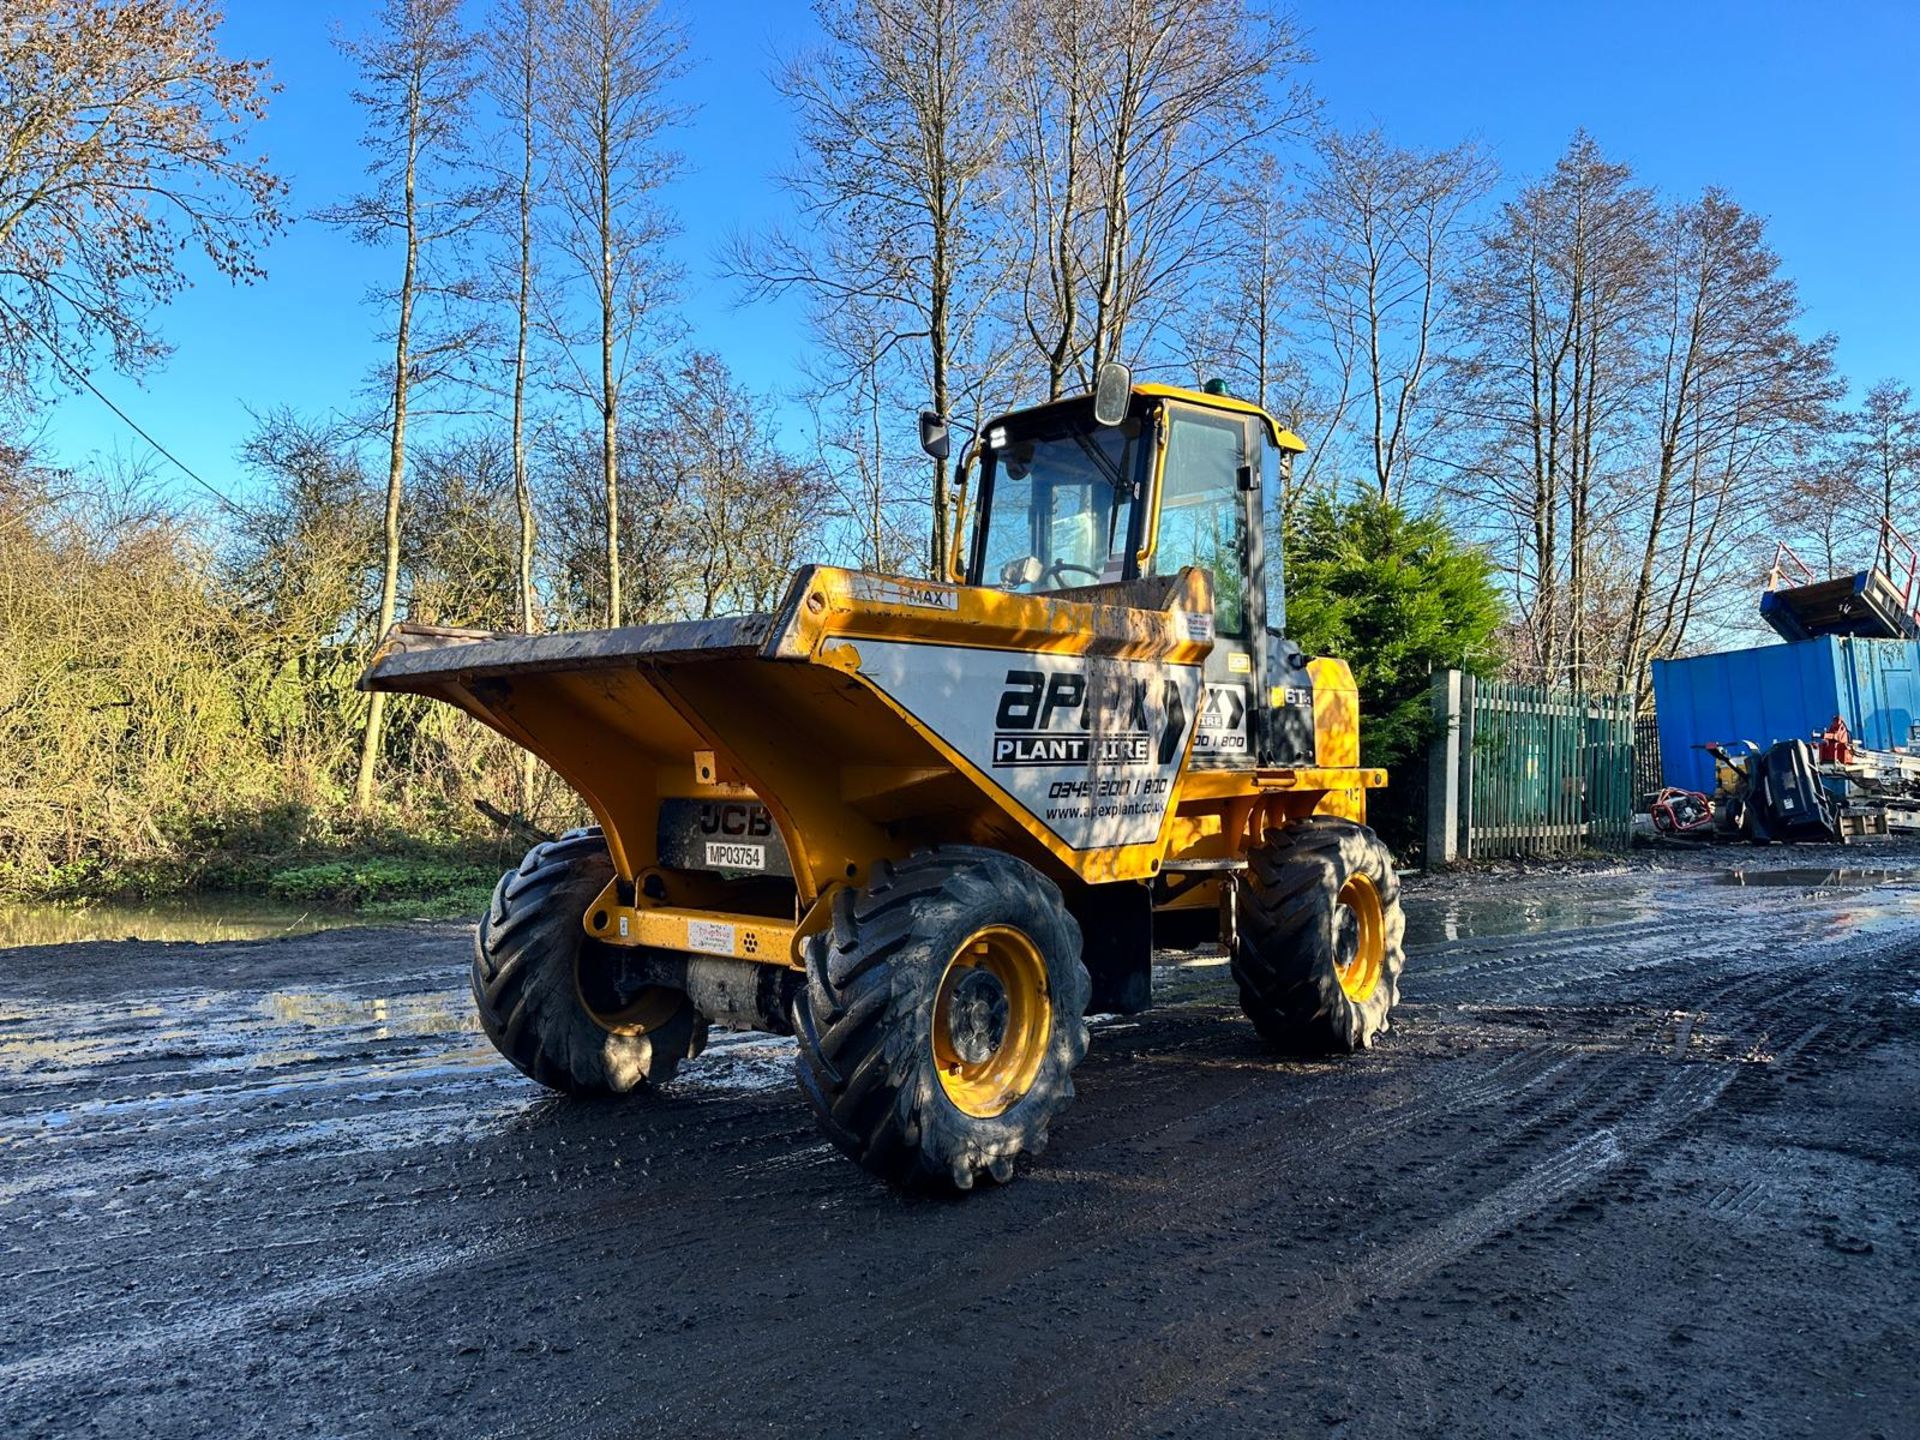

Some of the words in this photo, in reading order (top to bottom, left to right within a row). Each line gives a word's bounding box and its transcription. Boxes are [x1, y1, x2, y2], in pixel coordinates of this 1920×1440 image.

[996, 740, 1084, 760] PLANT
[1092, 740, 1147, 760] HIRE
[1048, 781, 1092, 799] 0345
[1143, 779, 1168, 795] 800
[700, 804, 772, 836] JCB
[709, 845, 760, 866] MP03754
